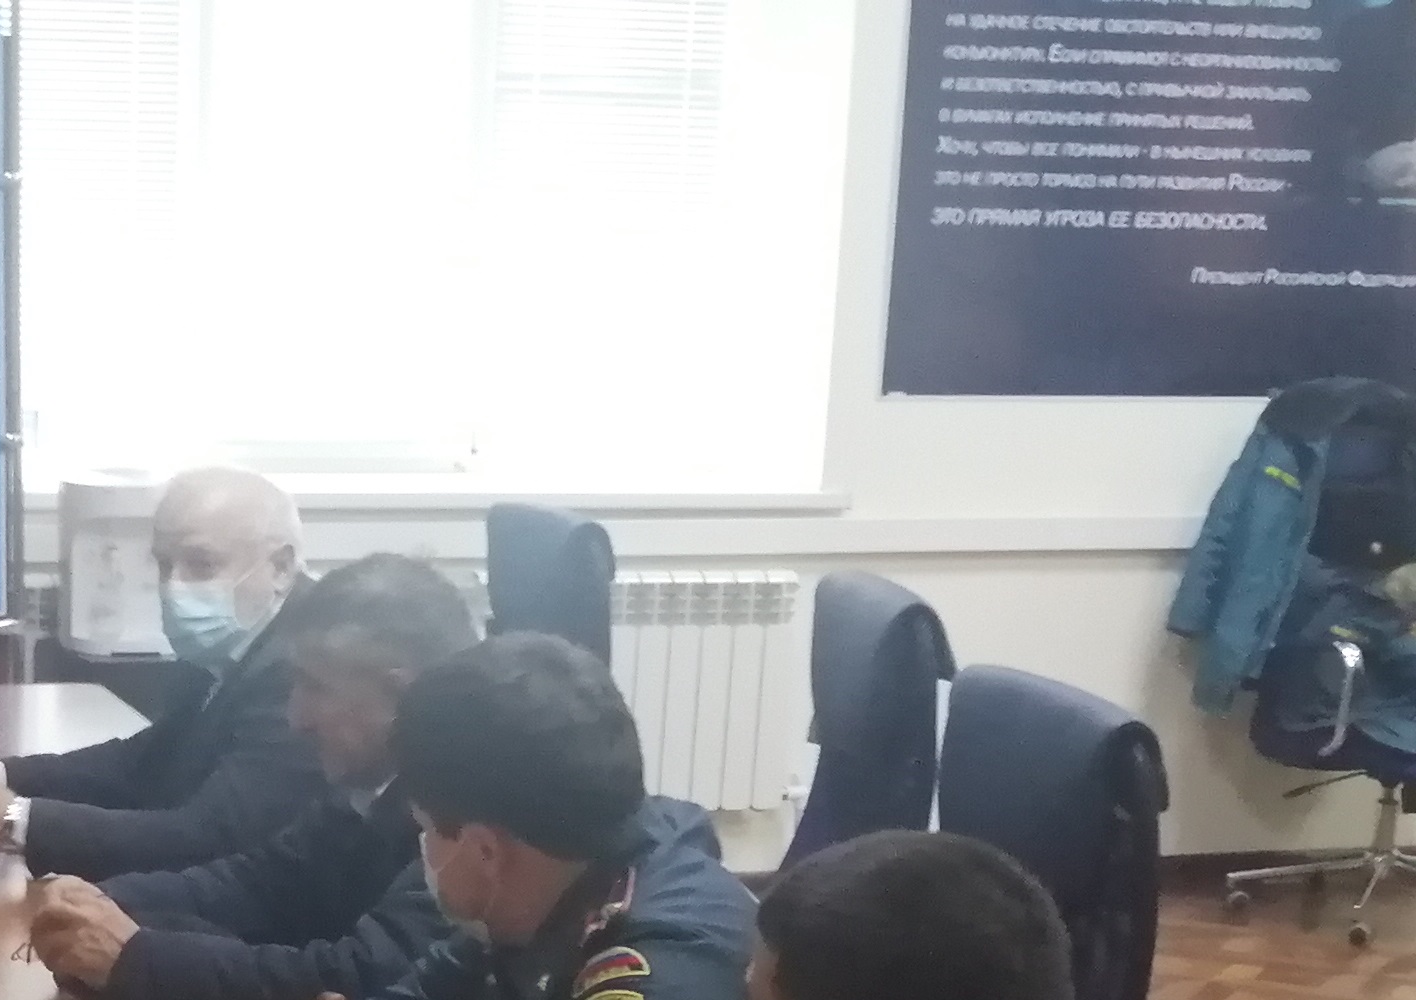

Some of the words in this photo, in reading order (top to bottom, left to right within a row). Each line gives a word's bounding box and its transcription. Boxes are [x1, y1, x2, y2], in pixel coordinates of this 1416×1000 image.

[930, 206, 966, 227] ЭТО
[966, 206, 1043, 228] ПРЯМАЯ
[1043, 208, 1106, 229] УГРОЗА
[1107, 210, 1133, 230] ЕЕ
[1133, 209, 1268, 231] БЕЗОПАСНОСТИ.
